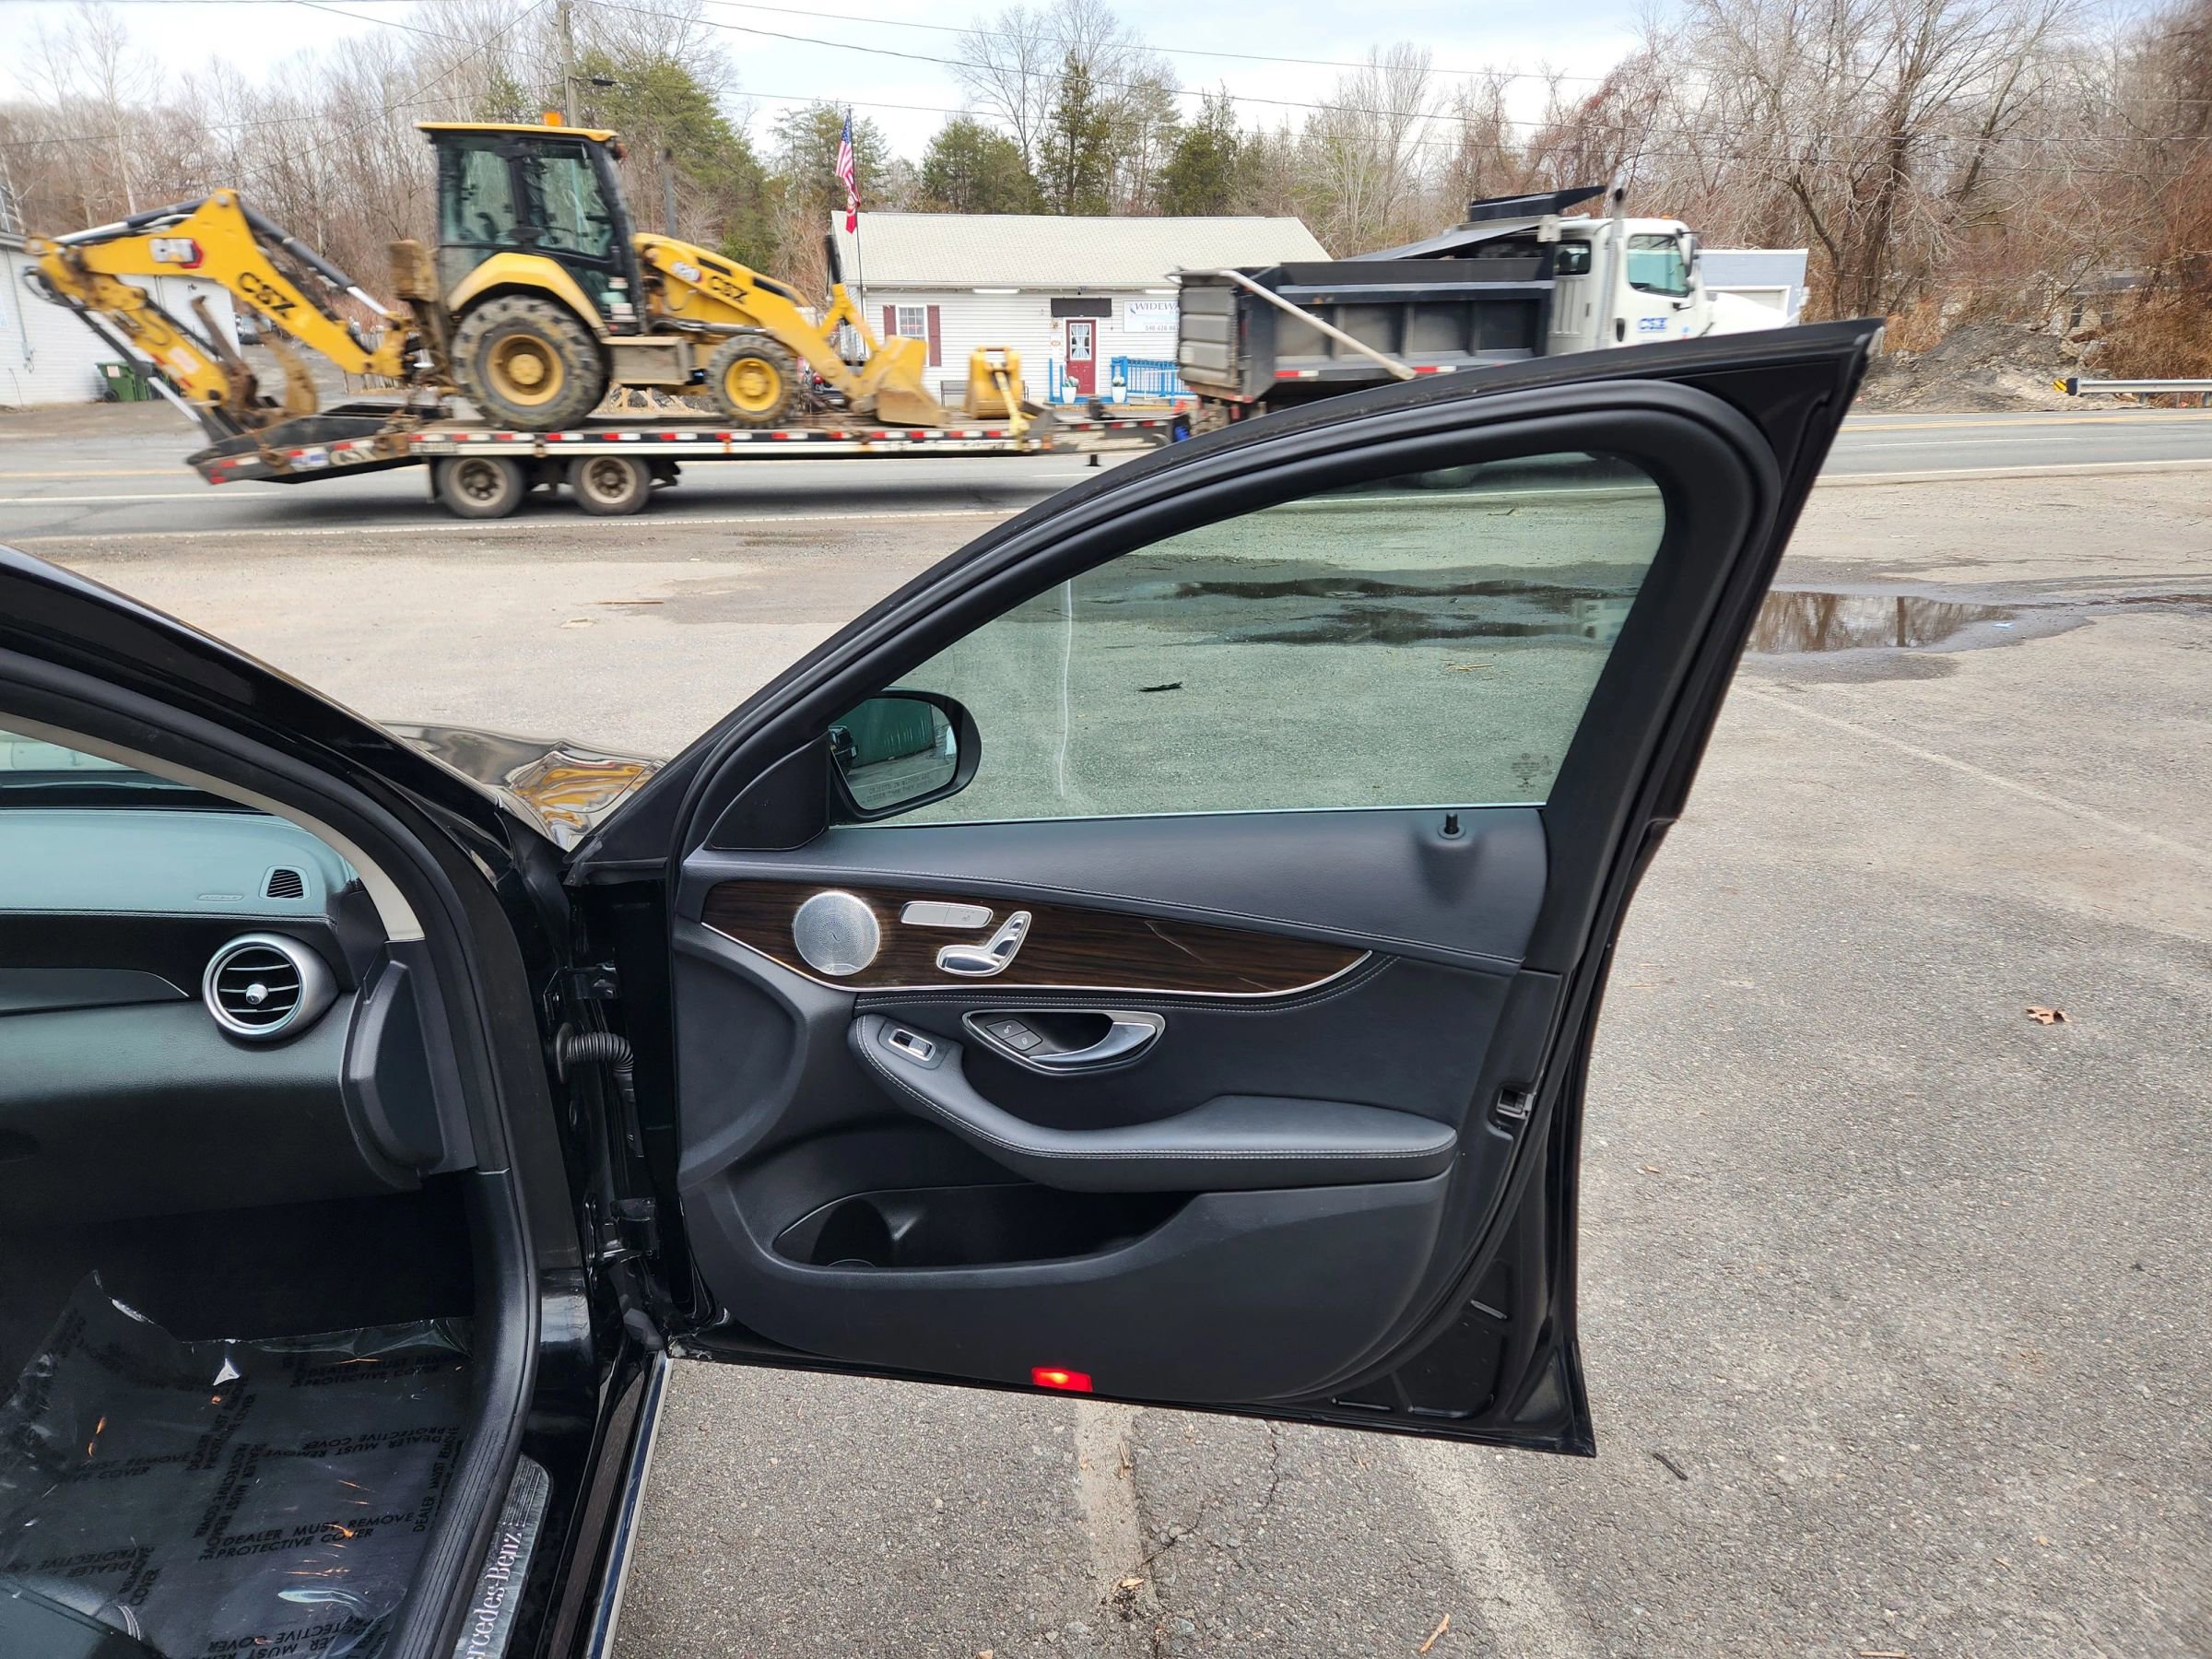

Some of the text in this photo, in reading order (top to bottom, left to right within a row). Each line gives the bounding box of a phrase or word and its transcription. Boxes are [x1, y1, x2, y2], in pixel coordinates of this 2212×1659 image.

[221, 1512, 416, 1547] DEALER MUST REMOVE
[413, 1495, 437, 1533] DEALER
[216, 1528, 374, 1558] PROTECTIVE COVER
[207, 1635, 270, 1653] COVER
